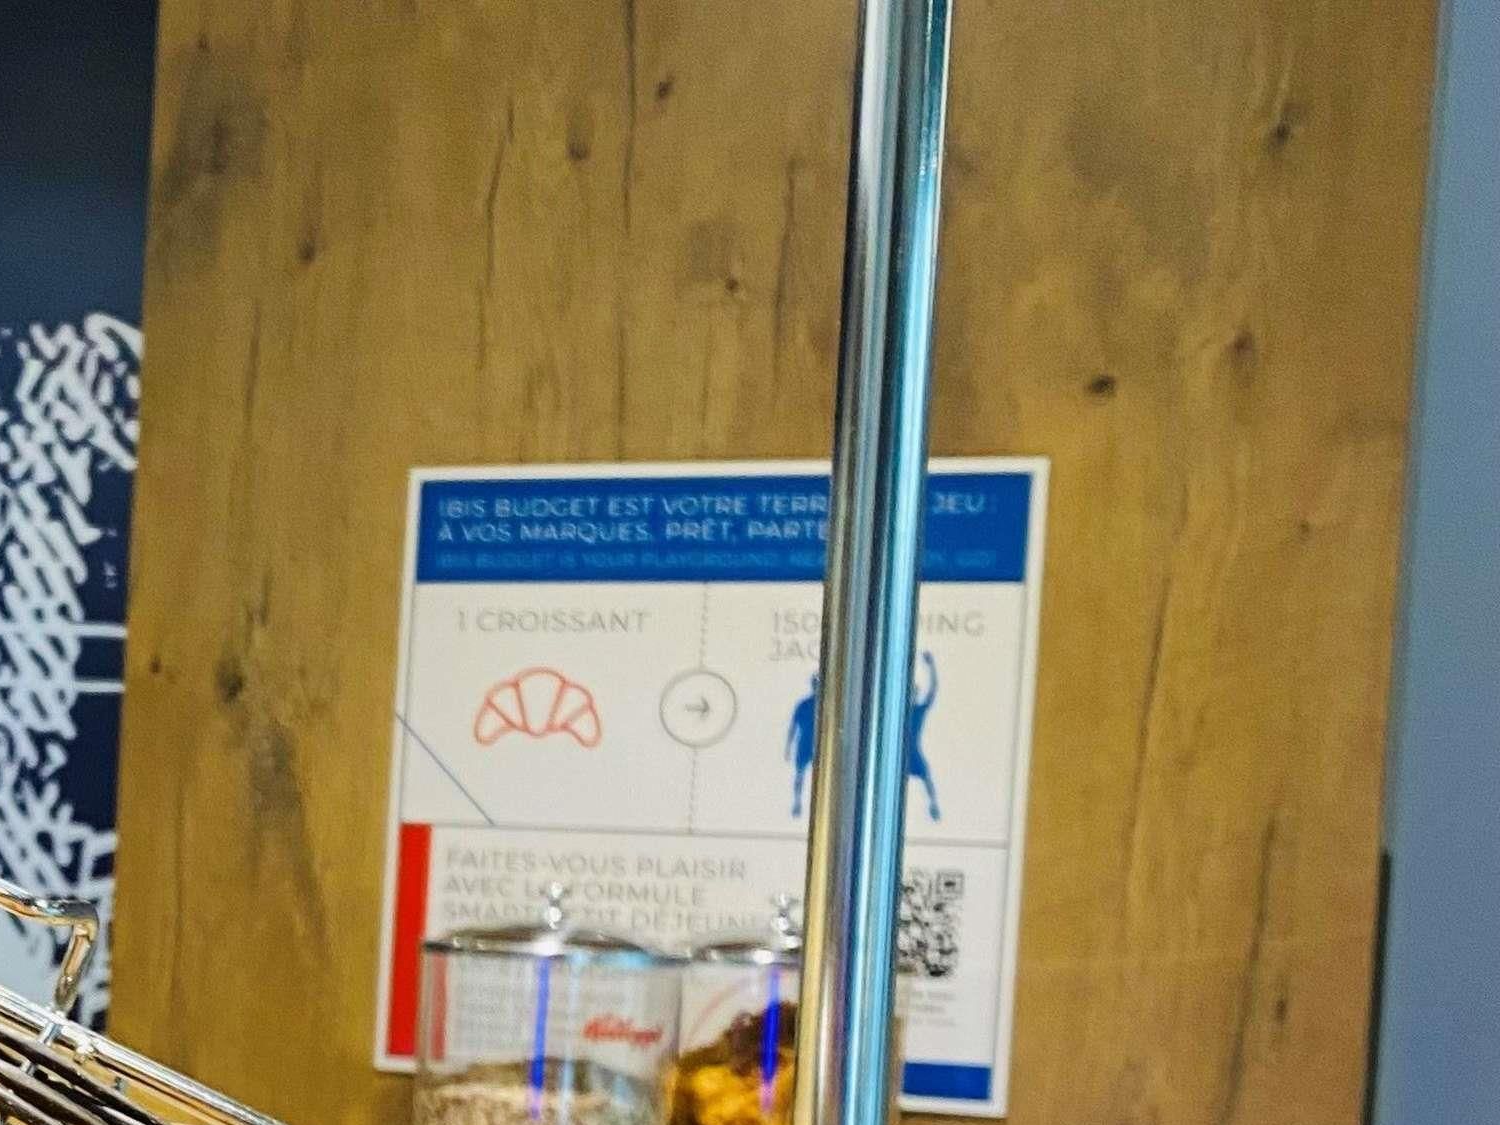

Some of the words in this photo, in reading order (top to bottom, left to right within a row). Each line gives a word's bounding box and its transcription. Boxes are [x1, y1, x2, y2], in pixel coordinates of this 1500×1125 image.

[494, 495, 600, 518] BUDGET
[606, 495, 654, 517] EST
[661, 494, 749, 516] VOTRE
[756, 493, 830, 515] TERR
[461, 522, 513, 543] VOS
[746, 518, 831, 541] PARTE
[475, 606, 651, 633] CROISSANT
[446, 848, 627, 877] FAITES-VOUS
[636, 855, 747, 881] PLAISIR
[443, 875, 515, 898] AVEC
